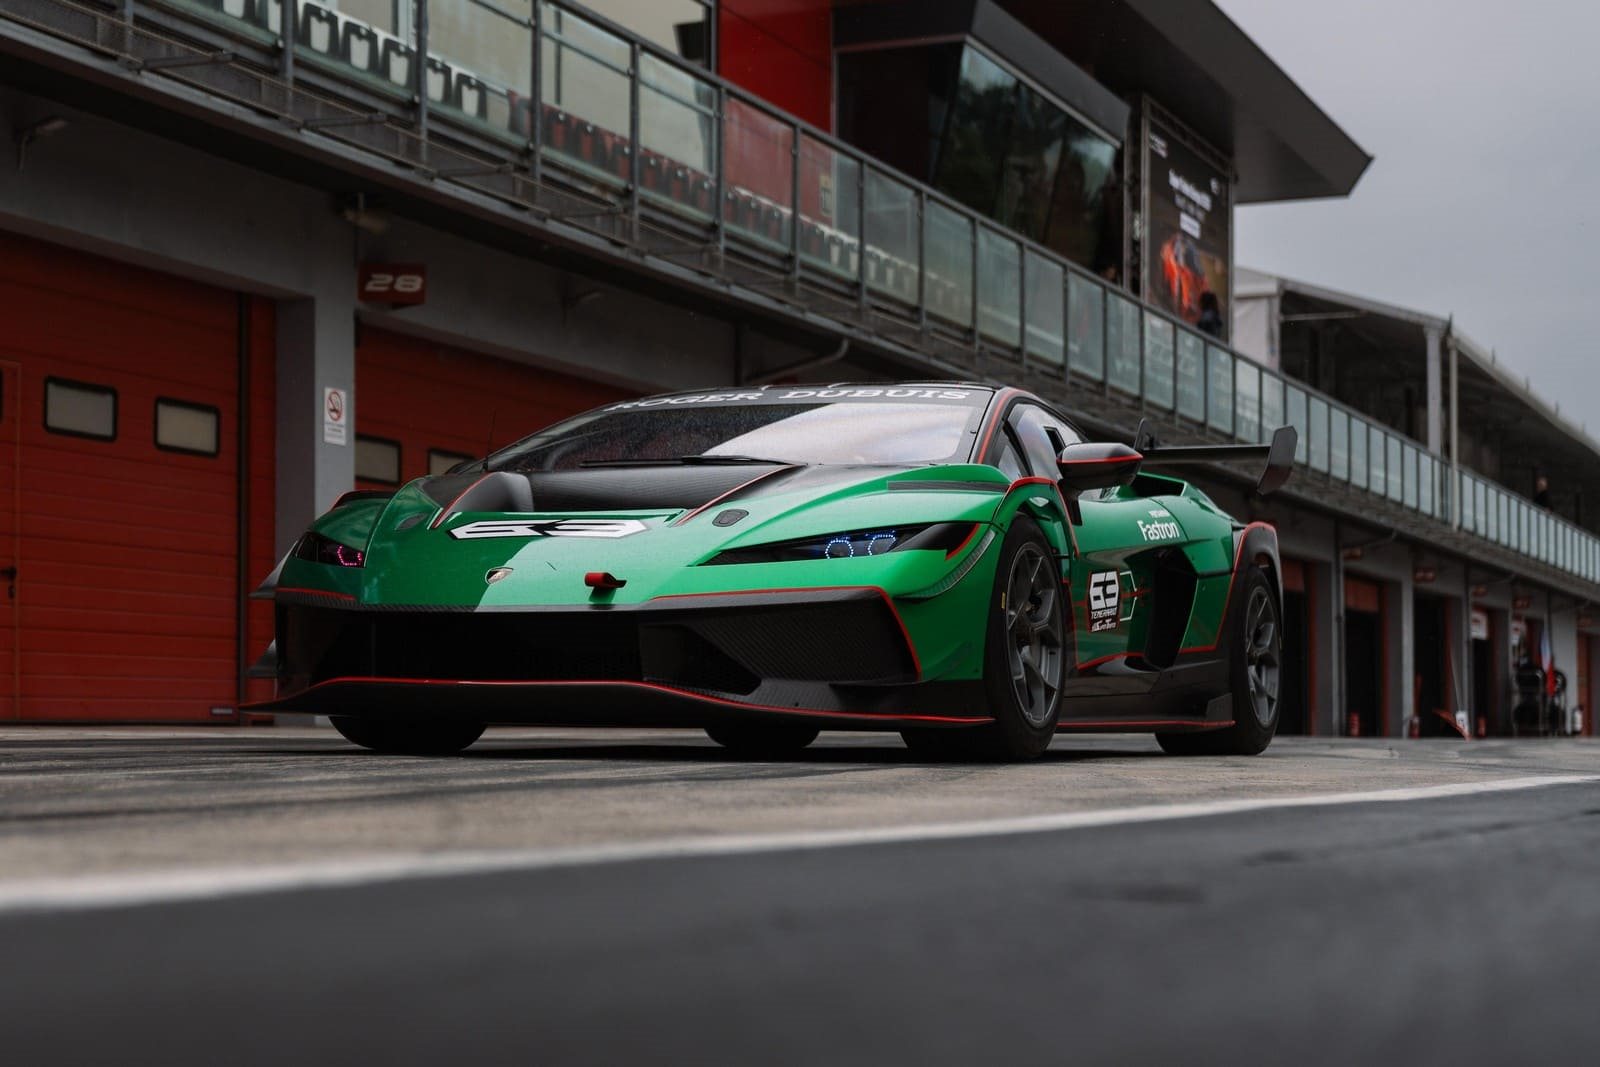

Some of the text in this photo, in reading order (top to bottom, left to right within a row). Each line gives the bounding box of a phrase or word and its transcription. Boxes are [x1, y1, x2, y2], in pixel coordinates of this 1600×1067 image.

[364, 273, 424, 293] 28
[602, 389, 971, 412] ROGER DUBUIS
[1136, 519, 1180, 541] Fastron
[1089, 571, 1119, 610] 63
